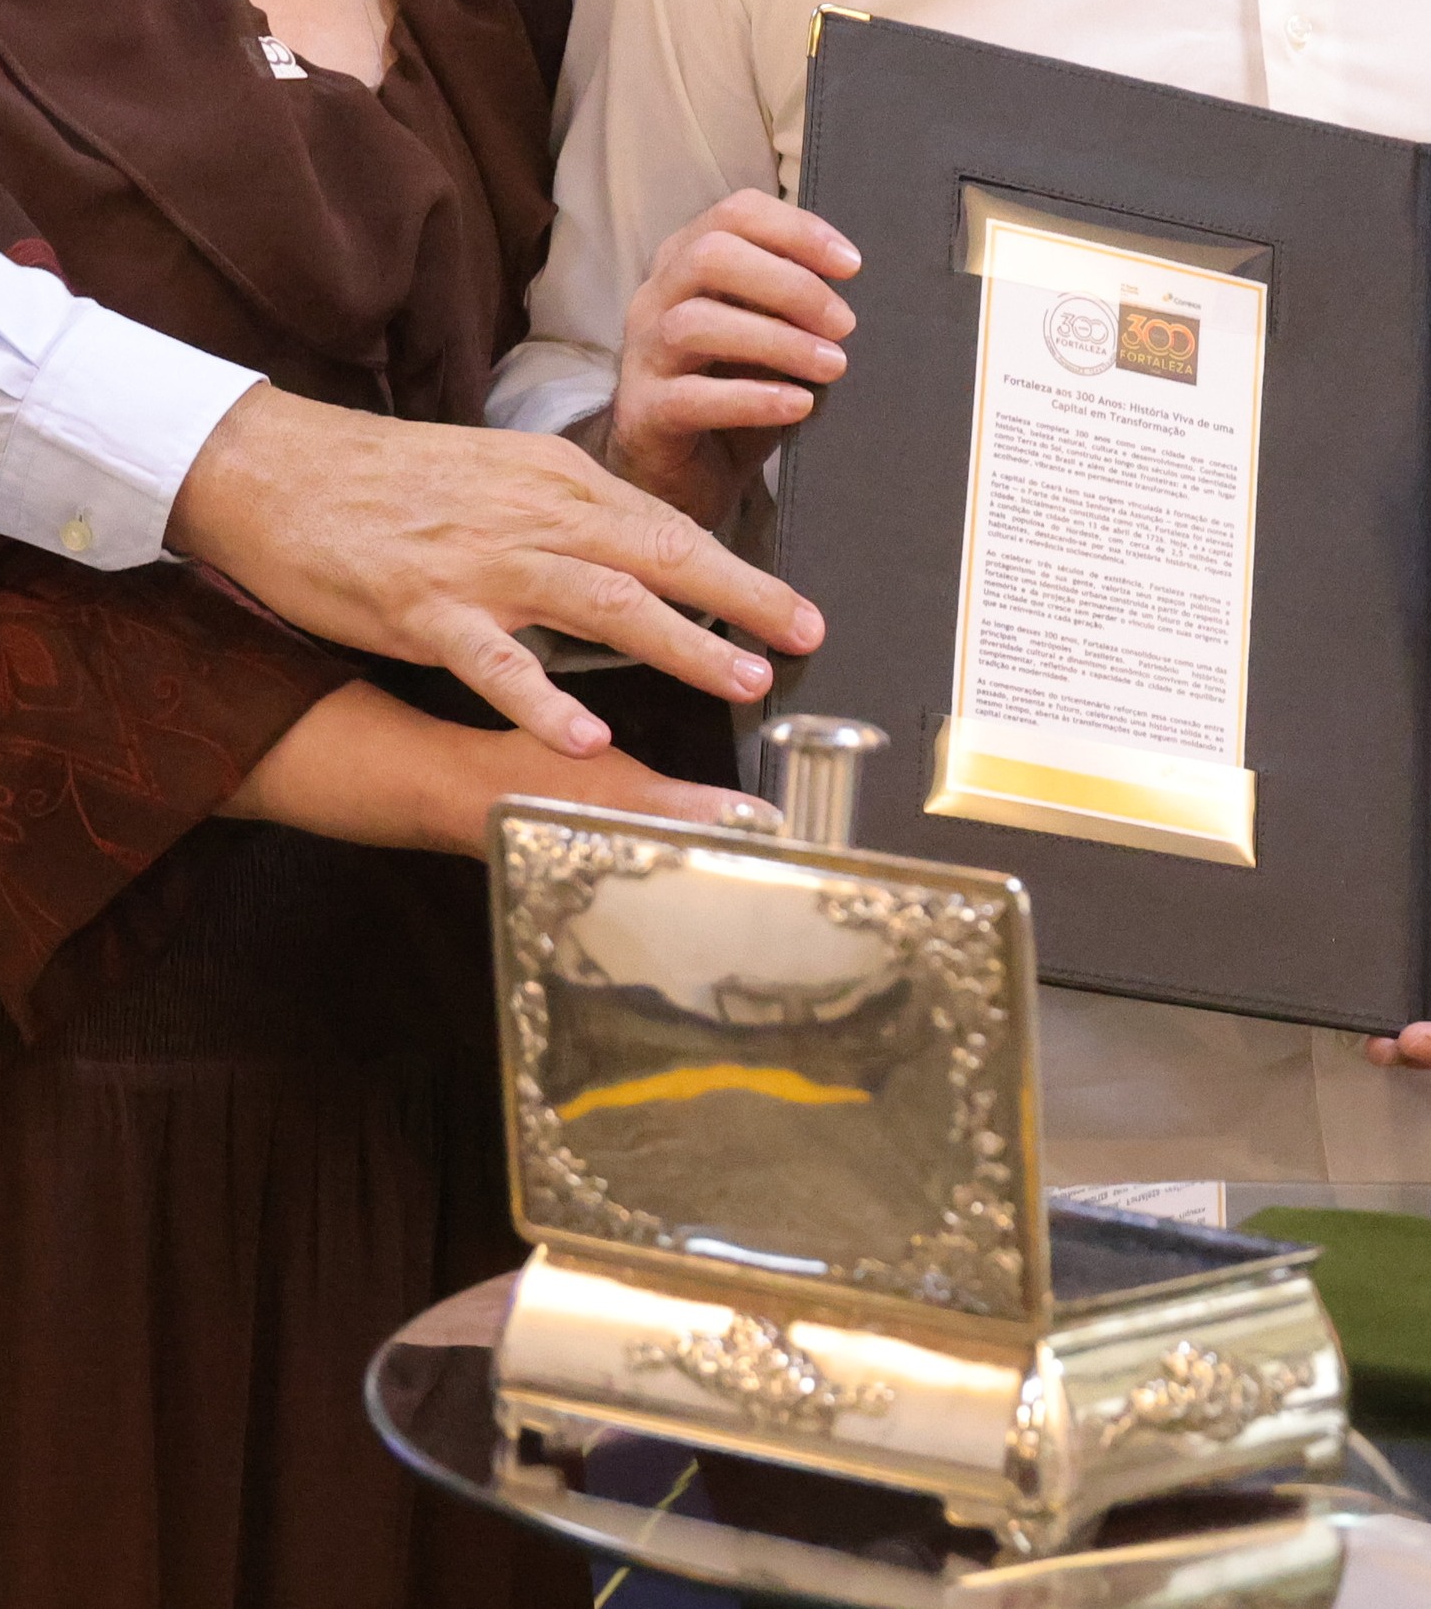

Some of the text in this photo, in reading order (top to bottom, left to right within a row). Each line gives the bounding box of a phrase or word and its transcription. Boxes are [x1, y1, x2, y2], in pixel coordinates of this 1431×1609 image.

[1056, 337, 1107, 356] FORTALEZA
[1057, 312, 1109, 345] 300
[1121, 313, 1195, 360] 300
[1120, 349, 1194, 376] FORTALEZA
[1003, 374, 1234, 434] Fortaleza aos 300 Anos: História Viva de uma
[1051, 399, 1185, 438] Capital em Transformação
